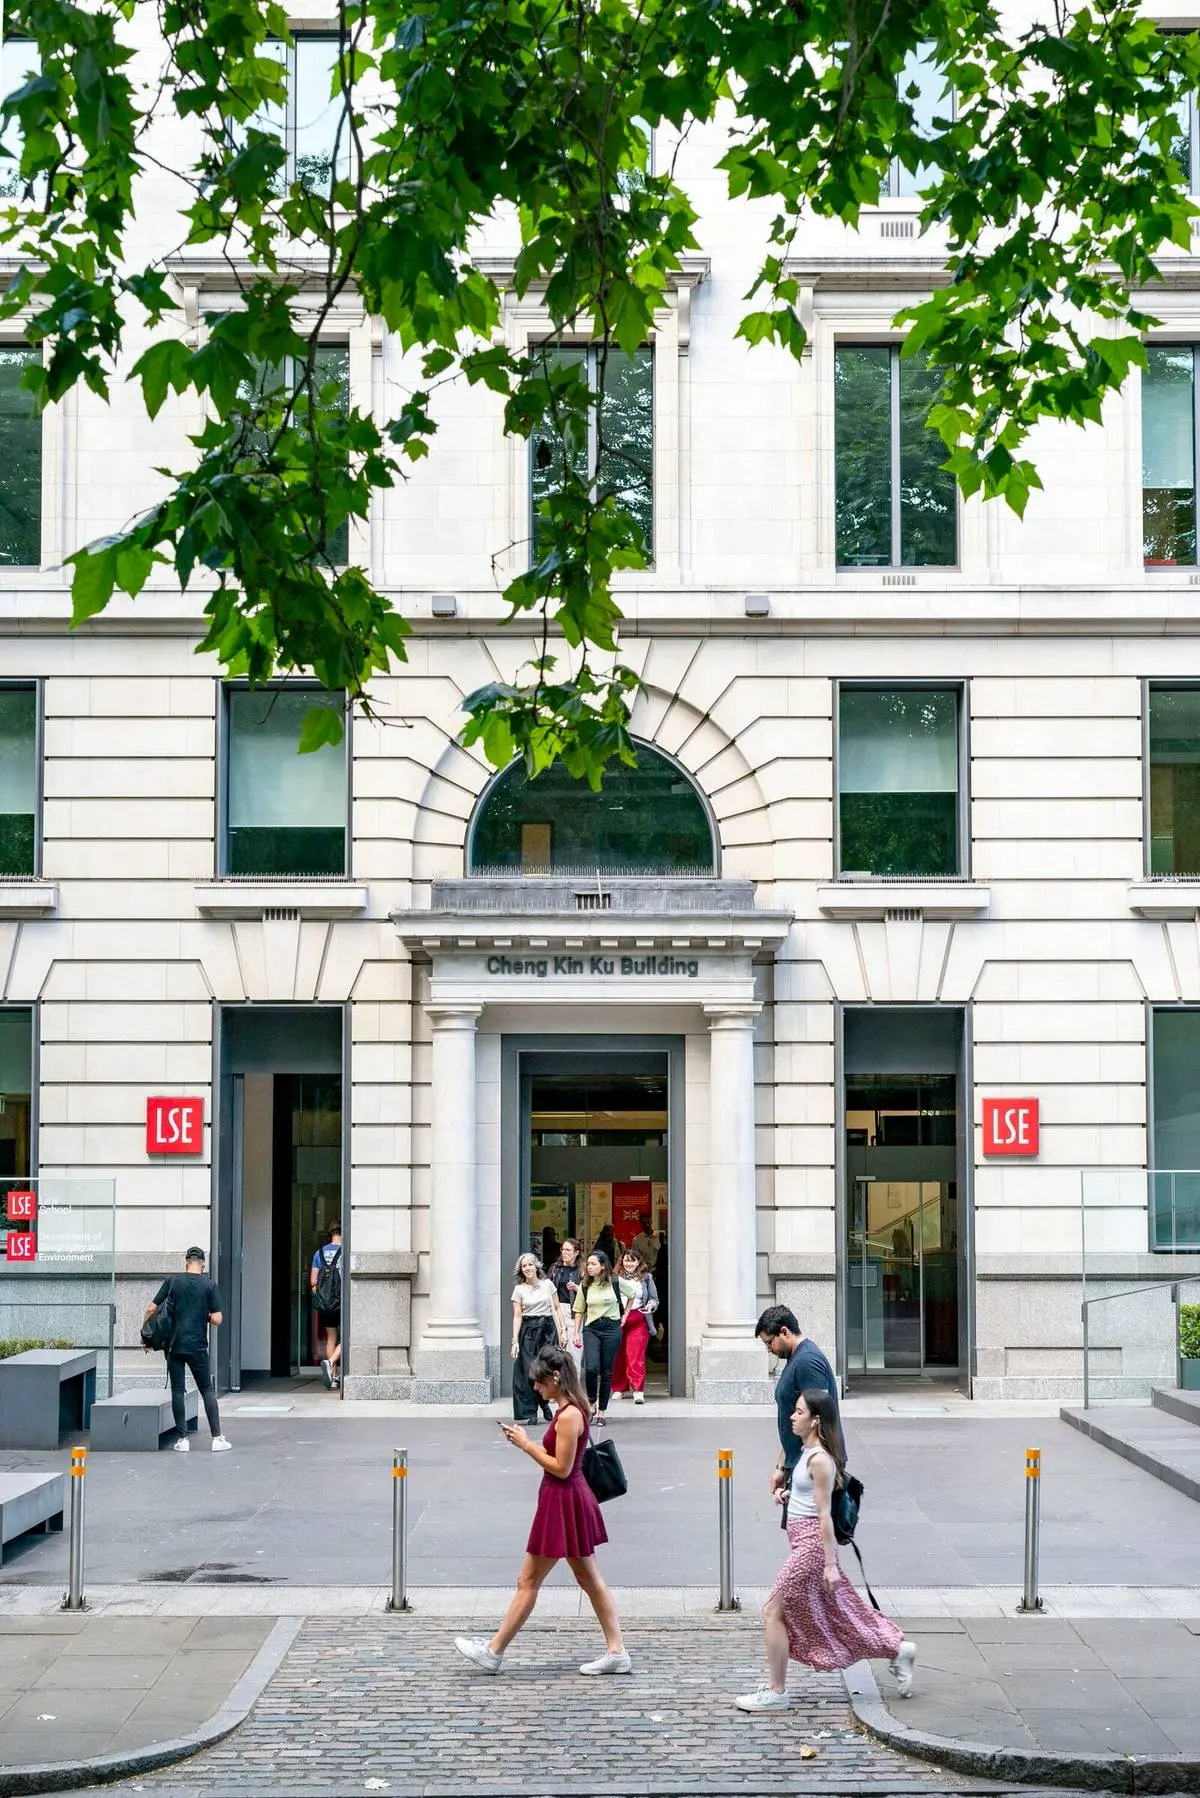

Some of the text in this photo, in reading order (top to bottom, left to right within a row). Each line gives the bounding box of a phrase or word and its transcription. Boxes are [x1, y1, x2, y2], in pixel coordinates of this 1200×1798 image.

[487, 956, 699, 977] Cheng Kin Ku Building
[156, 1107, 193, 1144] LSE
[993, 1108, 1030, 1145] LSE
[11, 1196, 32, 1215] LSE
[39, 1205, 72, 1216] School
[10, 1237, 31, 1257] LSE
[39, 1252, 94, 1261] Environment
